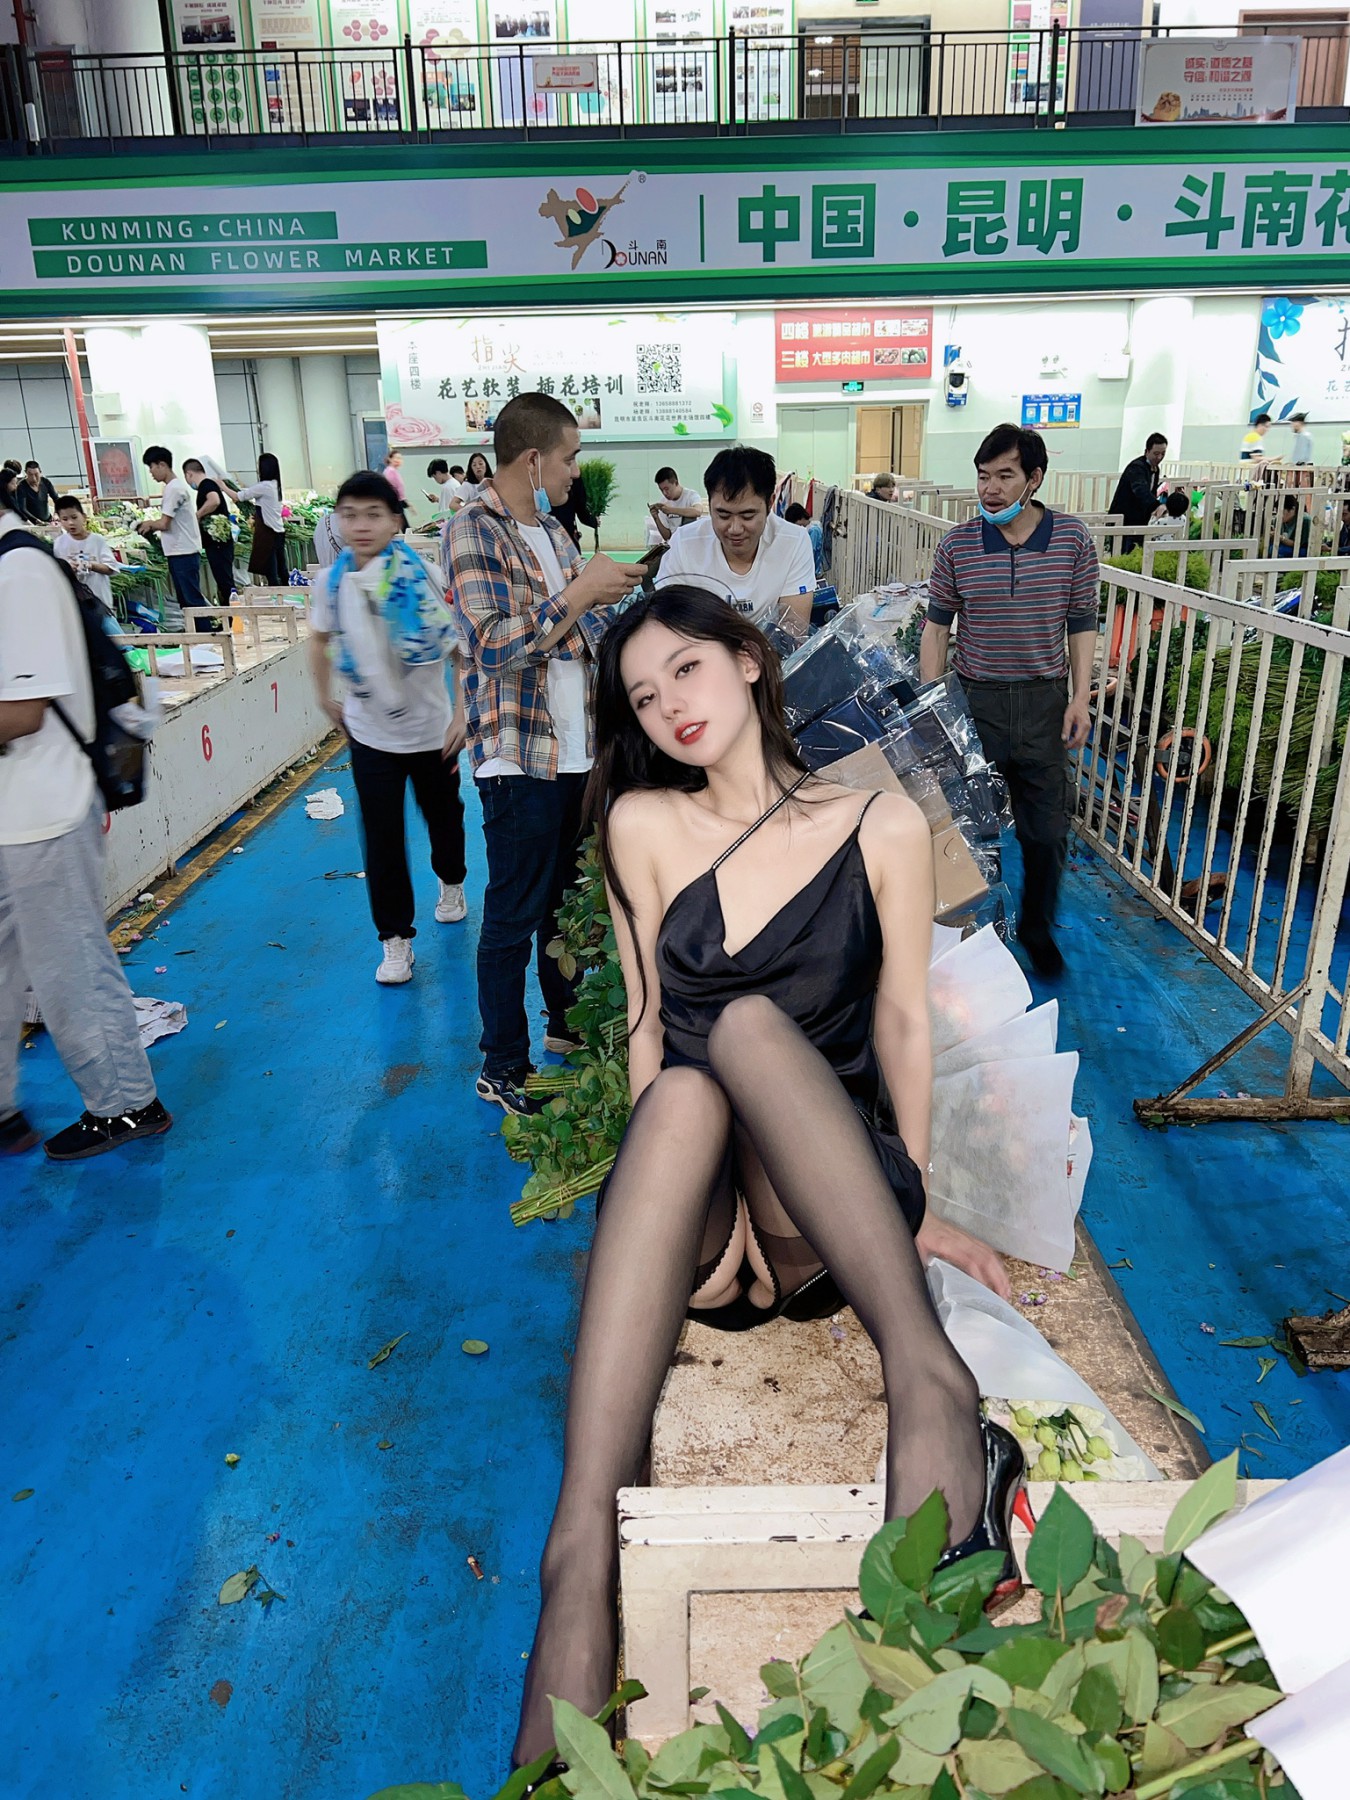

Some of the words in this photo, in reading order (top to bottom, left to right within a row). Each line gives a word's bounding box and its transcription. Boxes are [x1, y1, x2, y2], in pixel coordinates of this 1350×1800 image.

[66, 251, 186, 274] DOUNAN
[211, 249, 321, 271] FLOWER
[345, 247, 454, 268] MARKET
[781, 350, 809, 369] 三楼
[812, 350, 871, 366] 大型多肉超市
[536, 373, 624, 397] 插花培训
[270, 681, 279, 714] 7
[201, 724, 214, 763] 6
